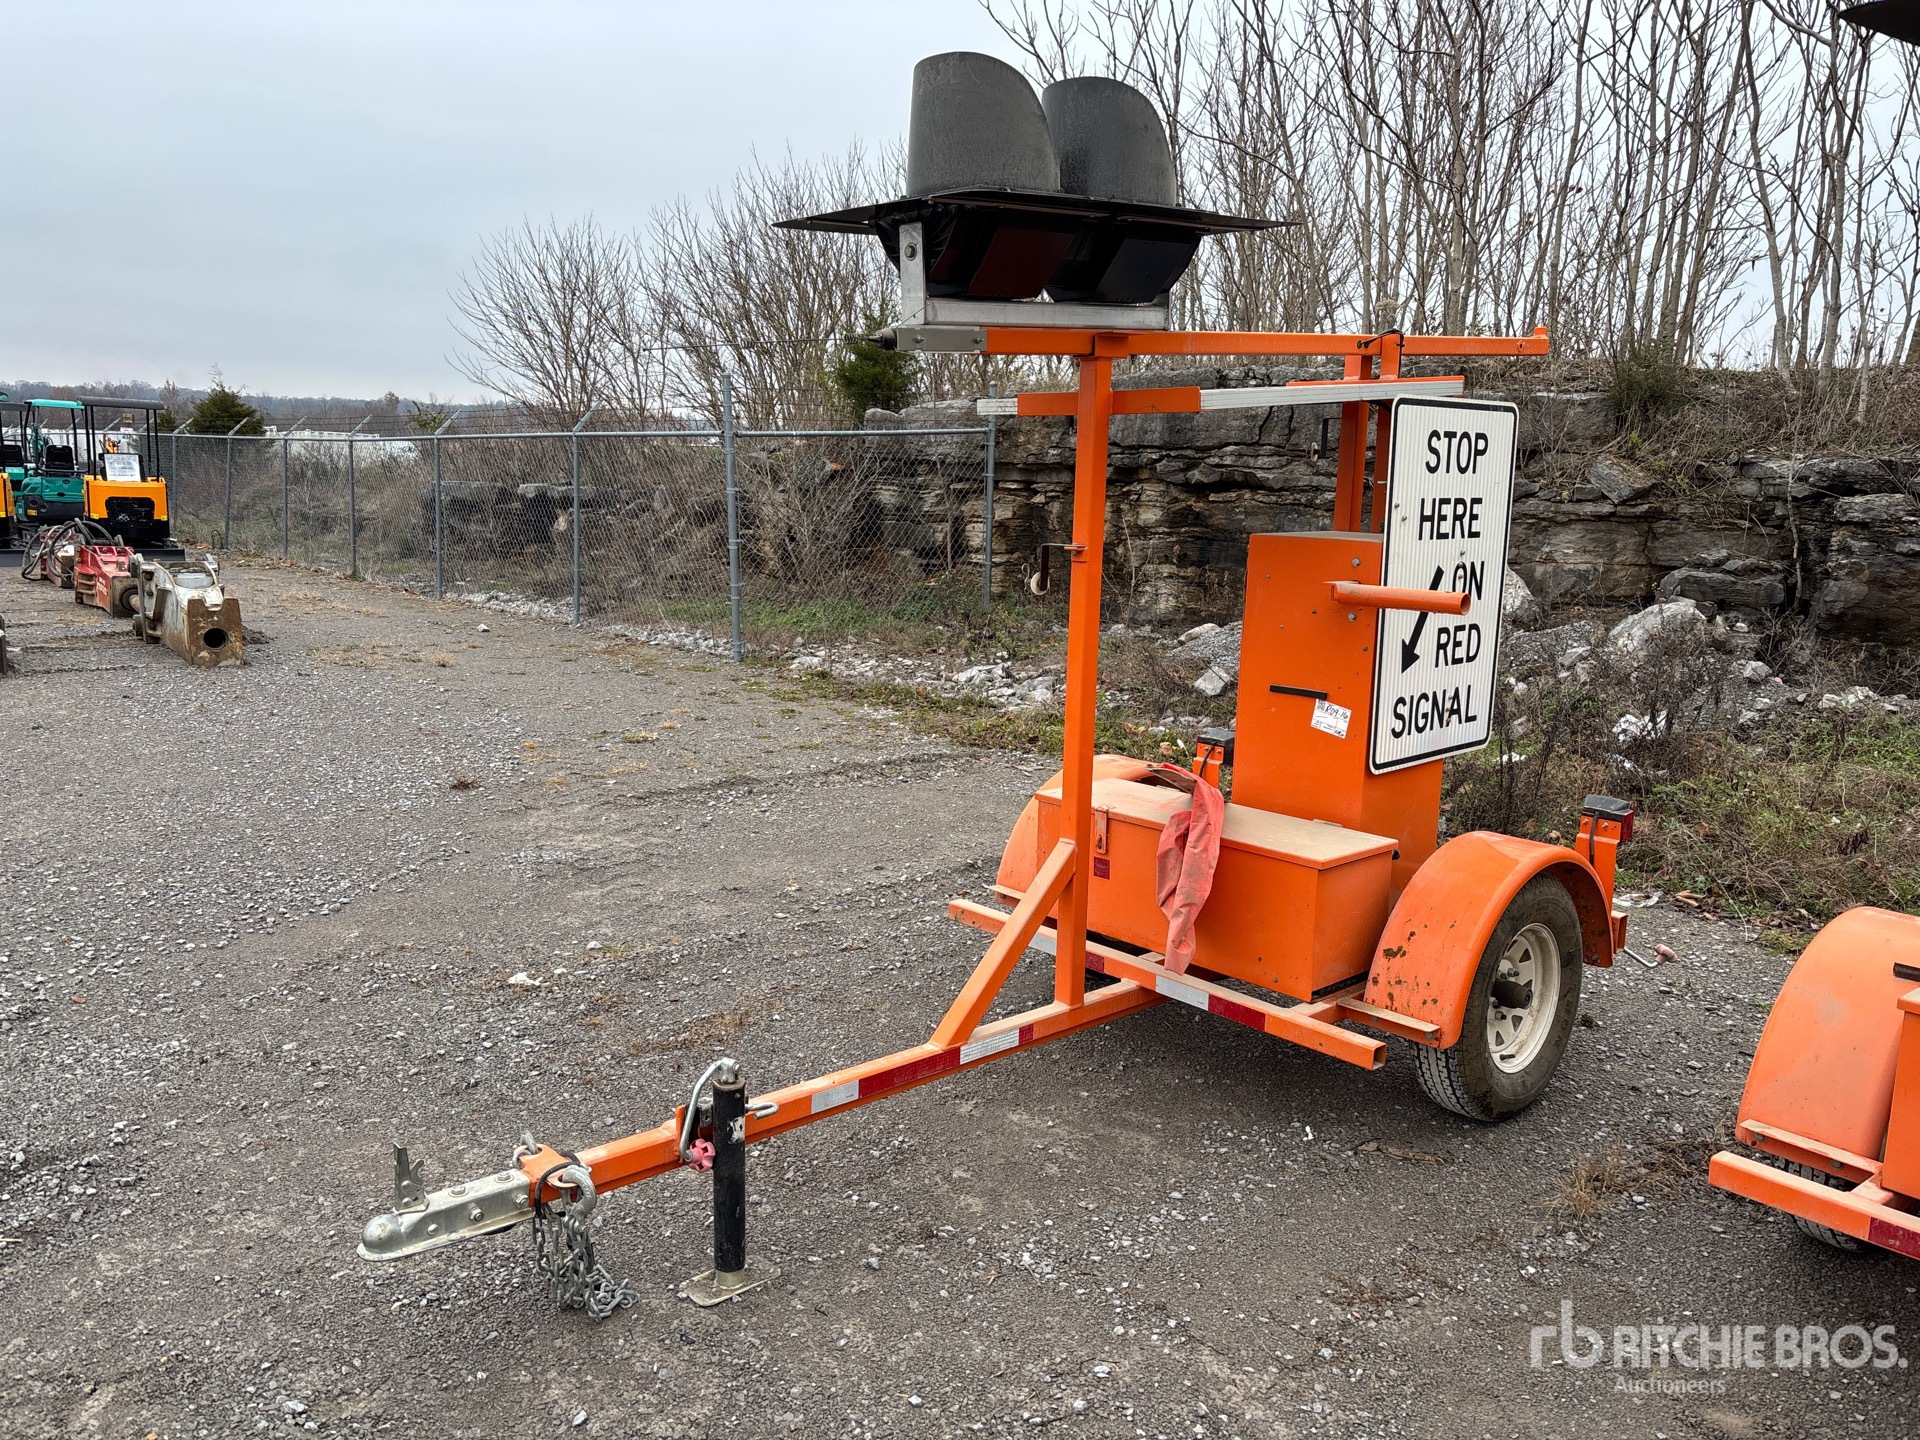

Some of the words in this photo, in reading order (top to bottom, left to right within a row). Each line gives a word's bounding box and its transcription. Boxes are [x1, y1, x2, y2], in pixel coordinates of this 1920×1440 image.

[1425, 429, 1489, 475] STOP
[1418, 497, 1483, 541] HERE
[1452, 560, 1485, 601] ON
[1435, 622, 1482, 668] RED
[1391, 684, 1478, 739] SIGNAL
